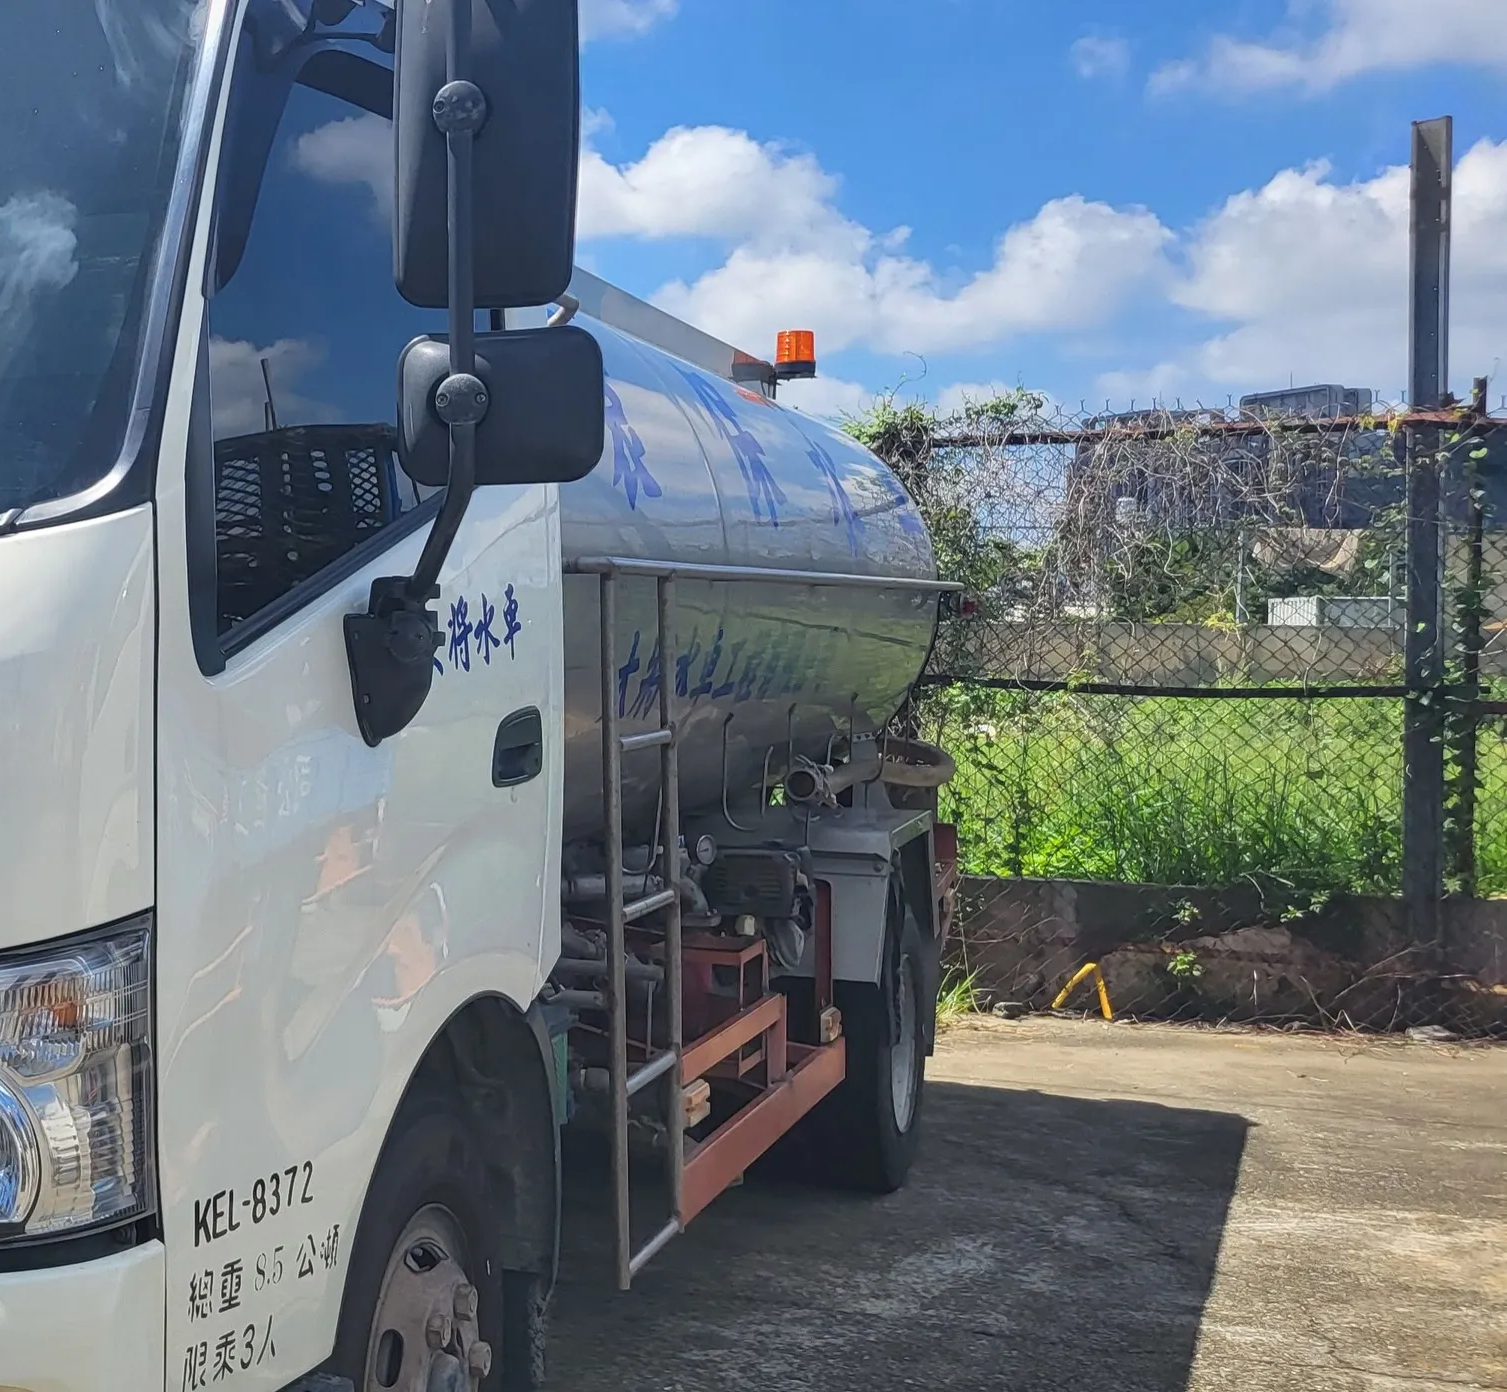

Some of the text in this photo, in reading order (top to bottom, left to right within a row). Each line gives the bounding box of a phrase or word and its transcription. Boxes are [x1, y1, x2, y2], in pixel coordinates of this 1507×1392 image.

[434, 583, 521, 676] 將水車
[194, 1160, 314, 1248] KEL-8372
